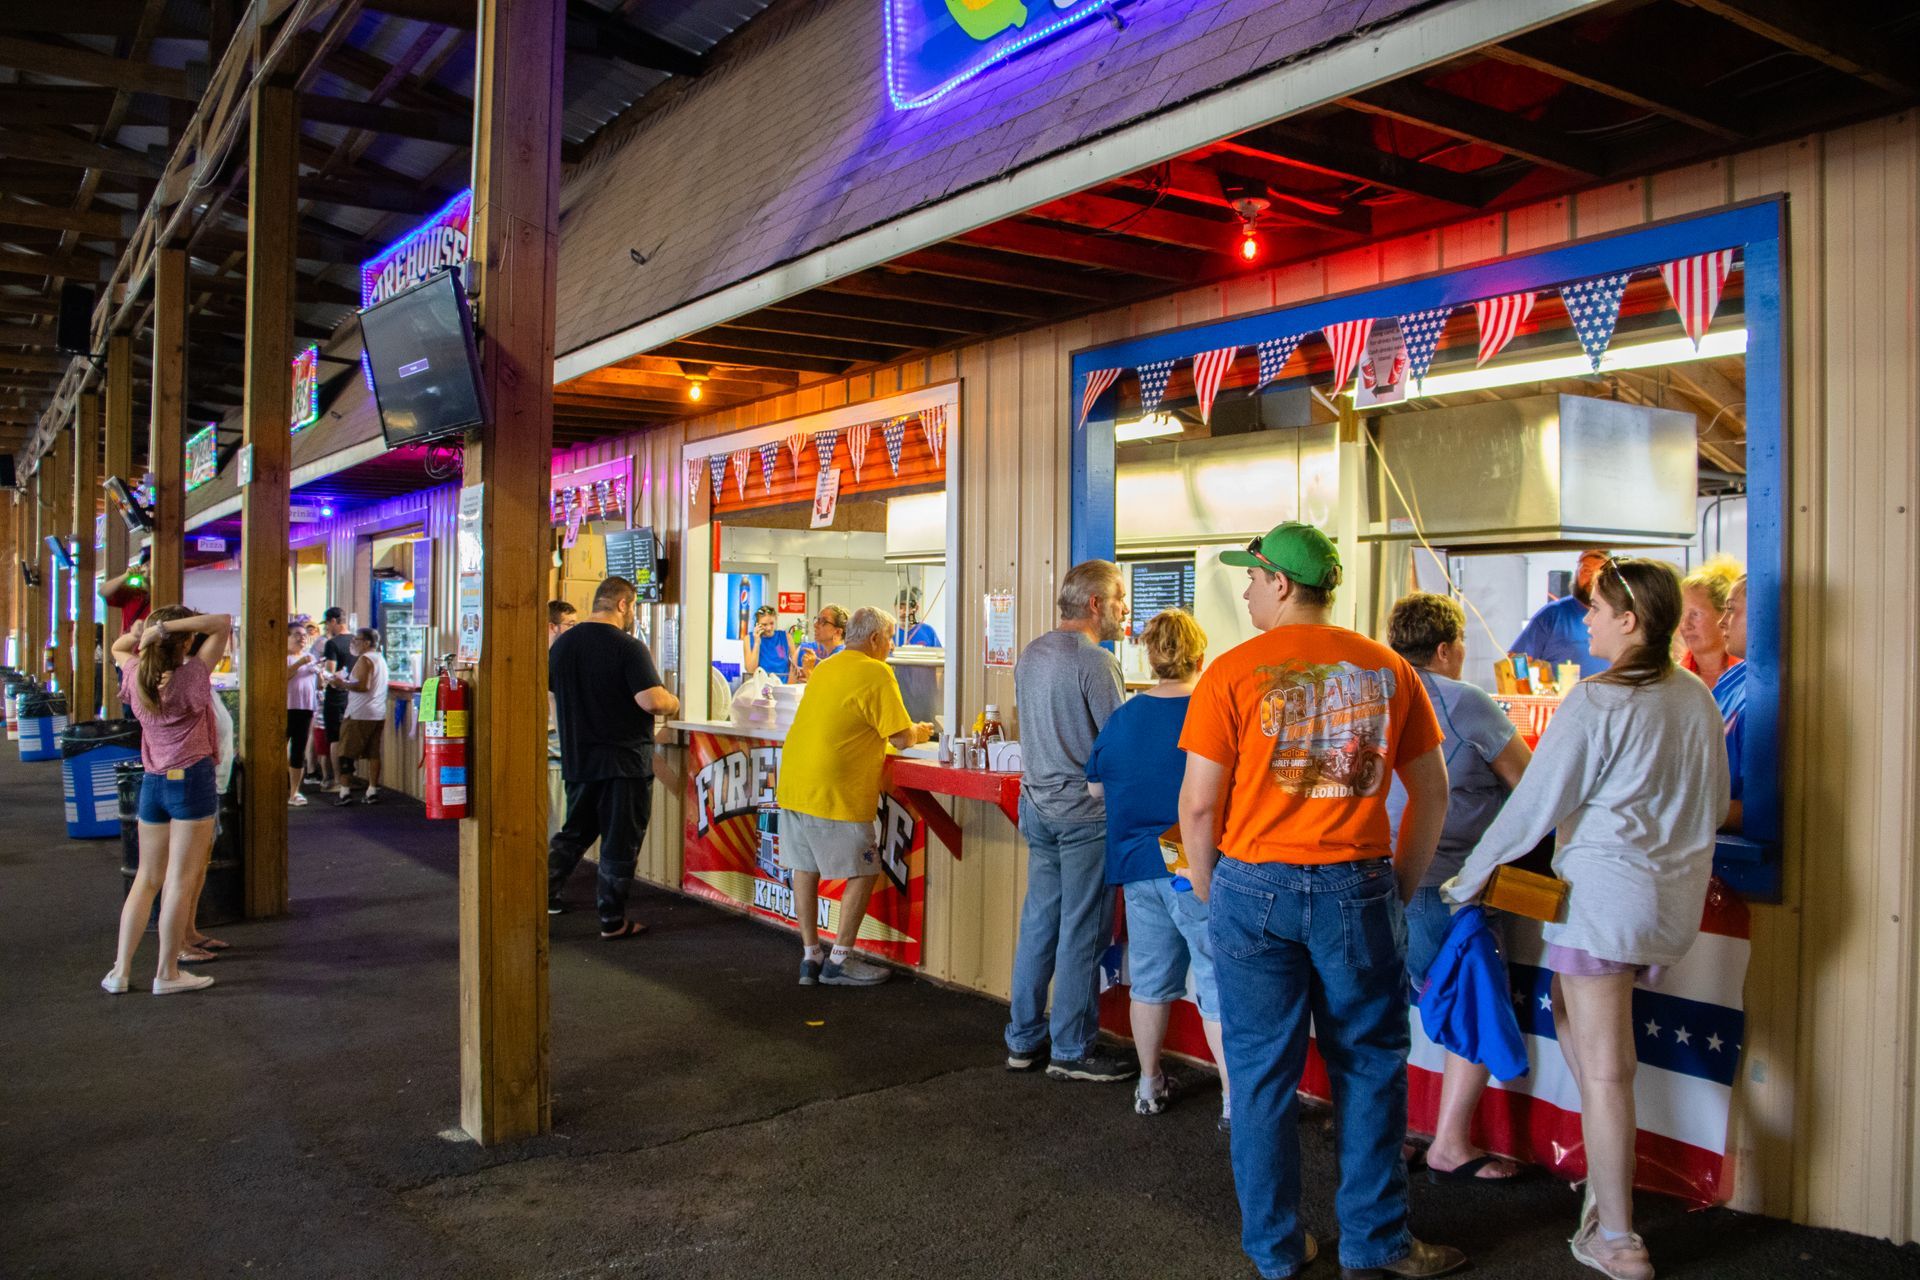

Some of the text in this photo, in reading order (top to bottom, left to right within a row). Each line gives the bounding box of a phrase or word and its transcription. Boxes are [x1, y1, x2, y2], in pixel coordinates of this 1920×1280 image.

[369, 225, 468, 306] FIREHOUSE
[199, 540, 223, 550] Pizza
[1260, 667, 1396, 736] ORLANDO
[1281, 748, 1306, 758] MOTOR
[695, 745, 915, 890] FIREE
[1304, 786, 1355, 799] FLORIDA
[753, 878, 831, 930] KITCN
